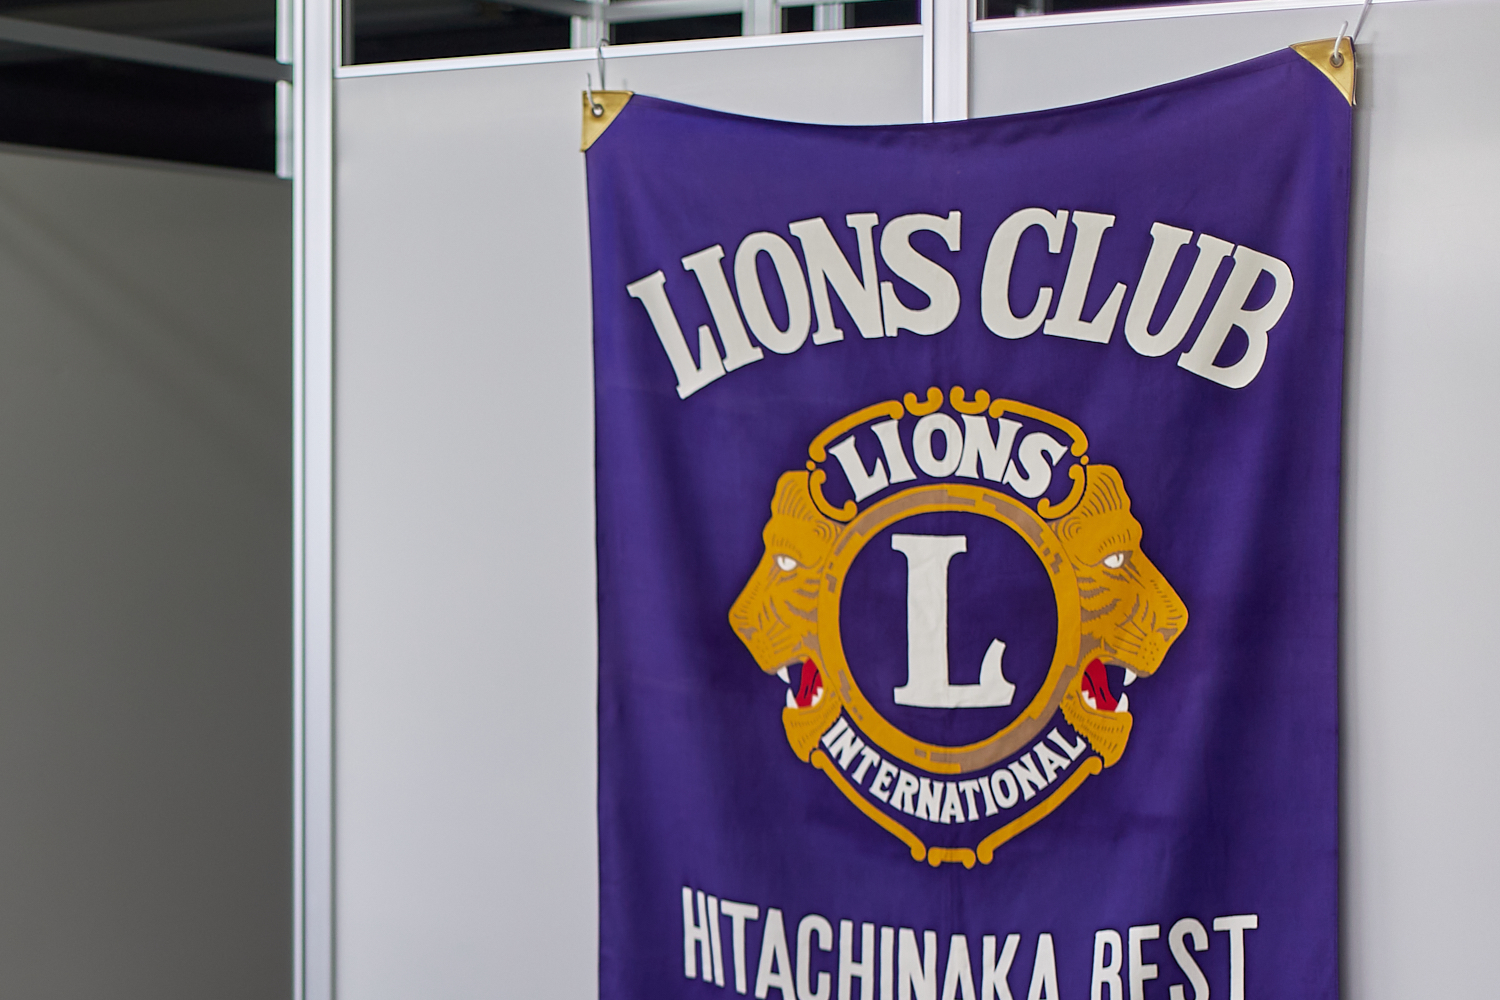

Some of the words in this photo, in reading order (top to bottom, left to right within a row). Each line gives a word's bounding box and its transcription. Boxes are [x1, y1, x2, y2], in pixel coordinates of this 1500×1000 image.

[626, 210, 962, 400] LIONS
[980, 207, 1294, 389] CLUB
[828, 412, 1069, 503] LIONS
[891, 533, 1016, 709] L
[821, 716, 1087, 824] INTERNATIONAL
